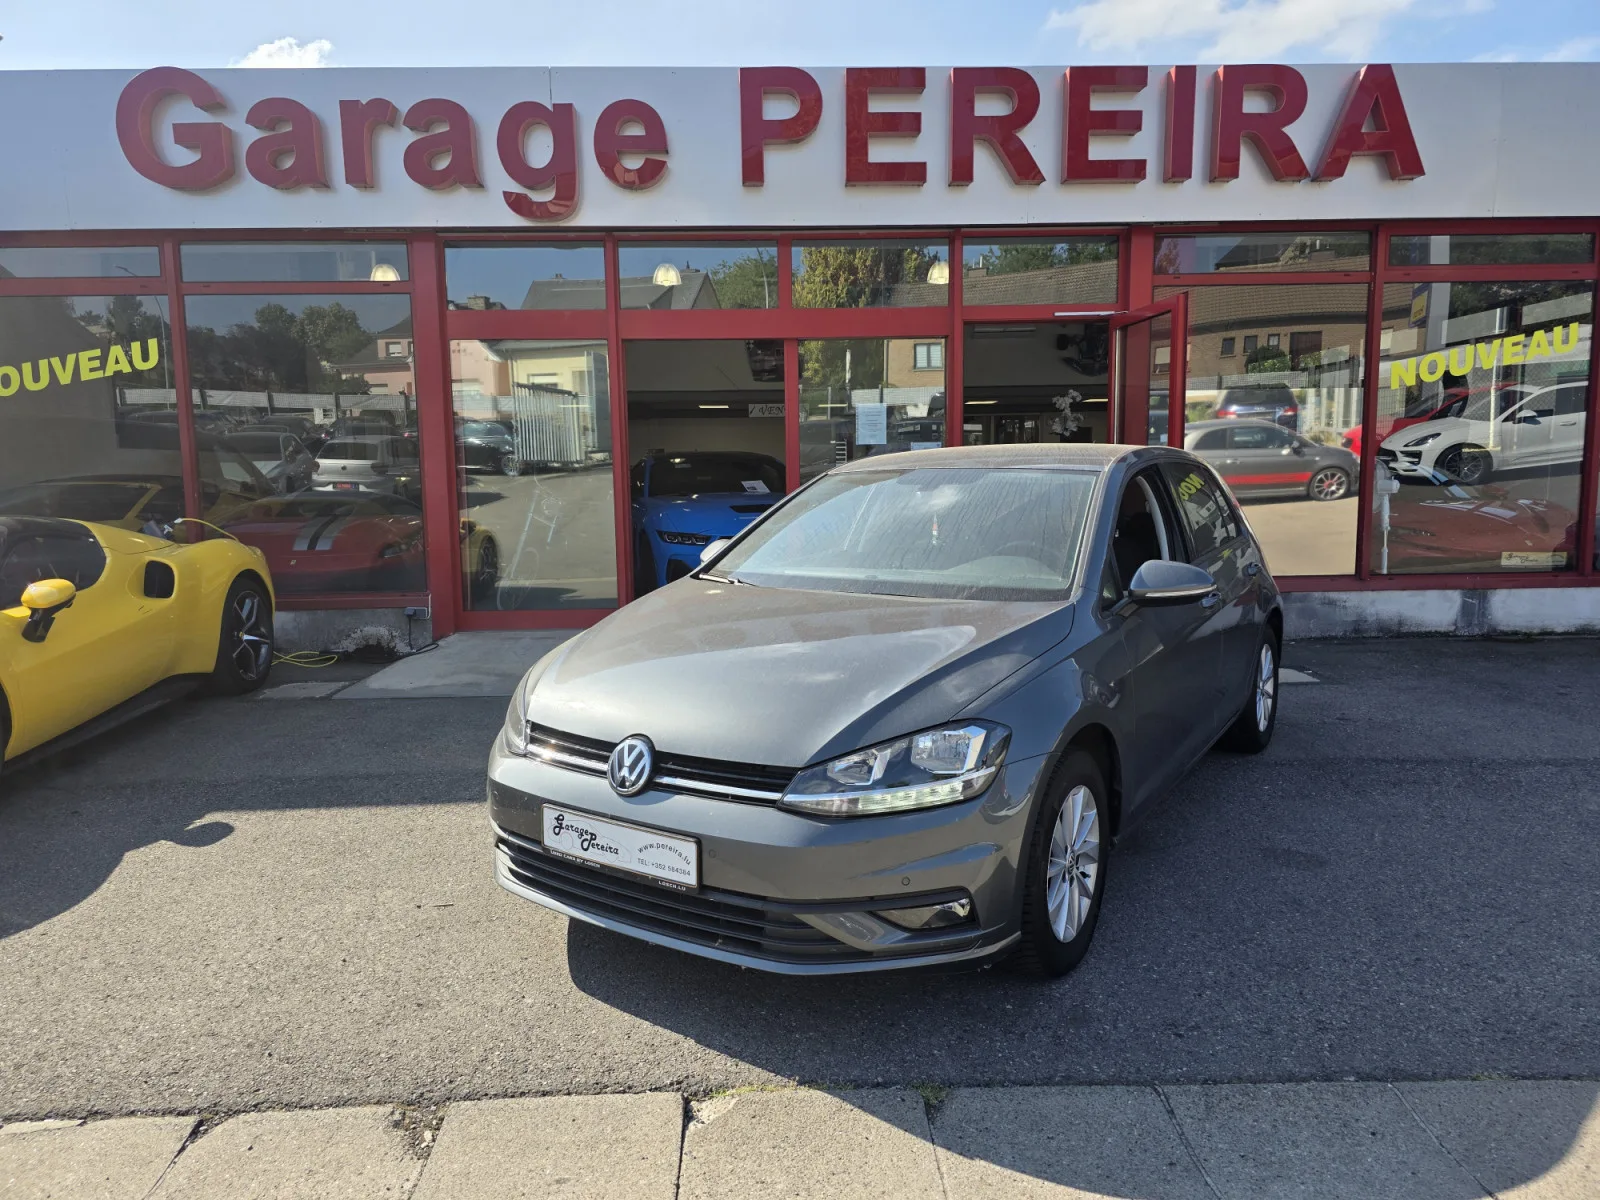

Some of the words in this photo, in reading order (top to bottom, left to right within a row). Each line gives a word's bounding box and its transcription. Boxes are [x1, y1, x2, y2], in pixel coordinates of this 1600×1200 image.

[115, 66, 669, 220] Garage
[739, 63, 1425, 187] PEREIRA
[1390, 322, 1579, 389] NOUVEAU
[553, 814, 589, 839] Garage
[580, 832, 619, 854] Pereira
[638, 842, 691, 866] www.pereira.lu
